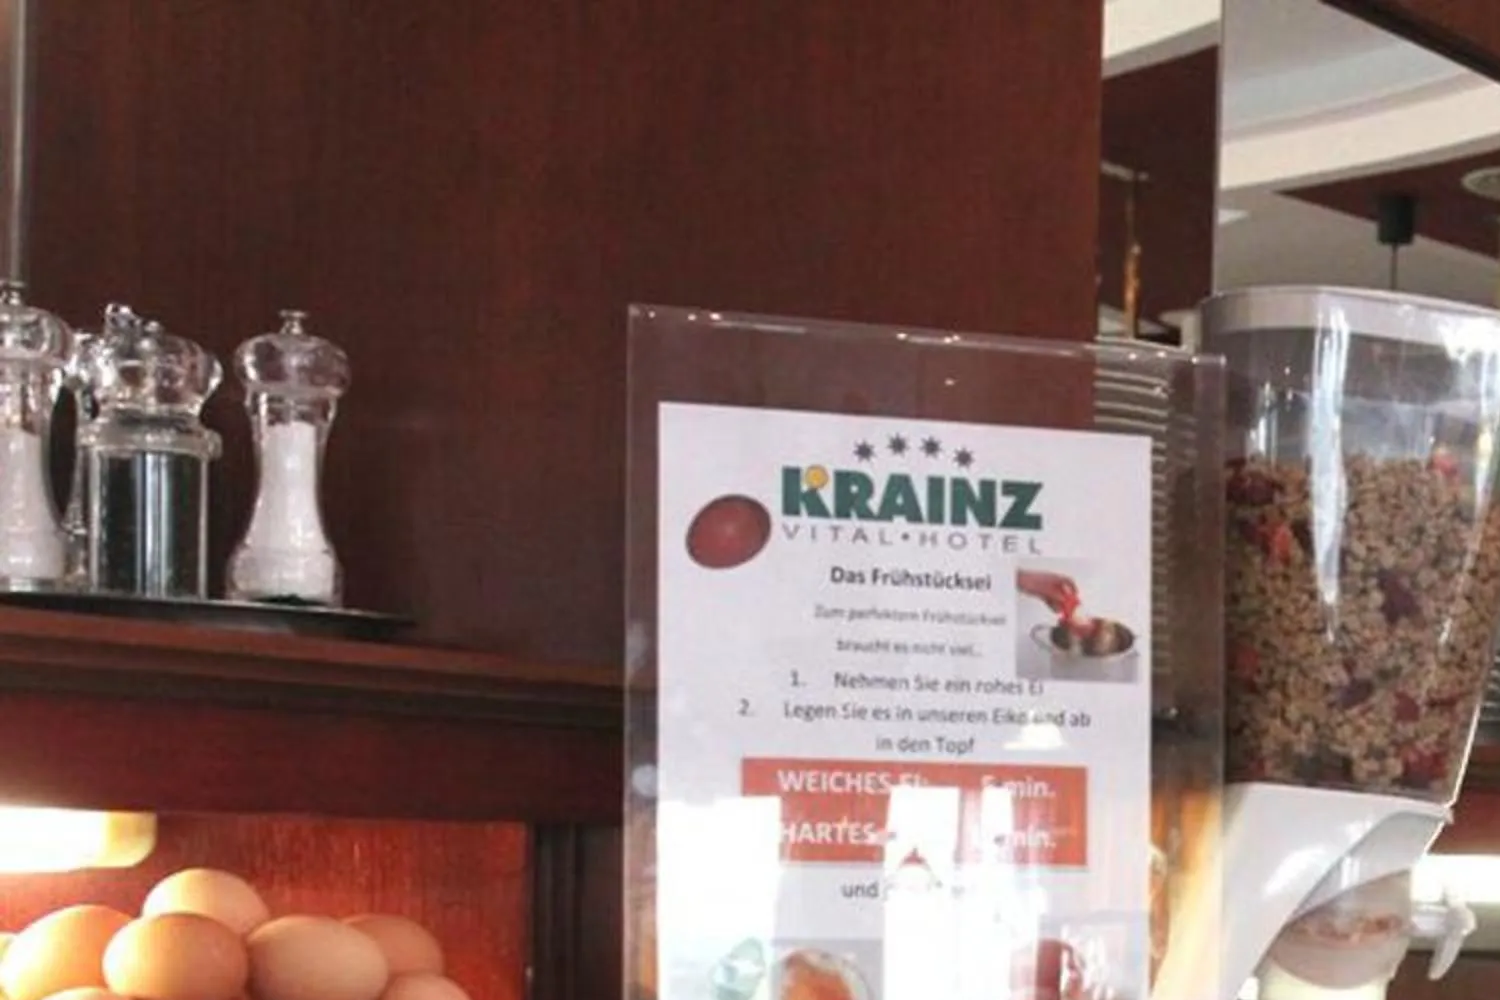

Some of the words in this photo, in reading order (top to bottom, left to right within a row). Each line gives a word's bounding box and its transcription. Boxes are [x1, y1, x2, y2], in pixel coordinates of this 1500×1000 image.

[781, 464, 1043, 531] KRAINZ
[782, 522, 893, 547] VITAL
[918, 530, 1042, 556] HOTEL
[830, 565, 866, 584] Das
[871, 566, 992, 592] Frühstücksei
[833, 671, 909, 690] Nehmen
[914, 673, 939, 692] Sie
[945, 675, 971, 693] ein
[975, 678, 1023, 696] rohes
[783, 701, 836, 723] Legen
[841, 702, 868, 721] Sie
[872, 706, 891, 721] es
[896, 704, 912, 721] in
[918, 706, 987, 724] unseren
[1070, 710, 1091, 728] ab
[876, 733, 893, 751] in
[897, 735, 930, 752] den
[936, 736, 974, 755] Topf
[777, 769, 892, 795] WEICHES
[780, 821, 876, 846] HARTES
[841, 881, 880, 899] und
